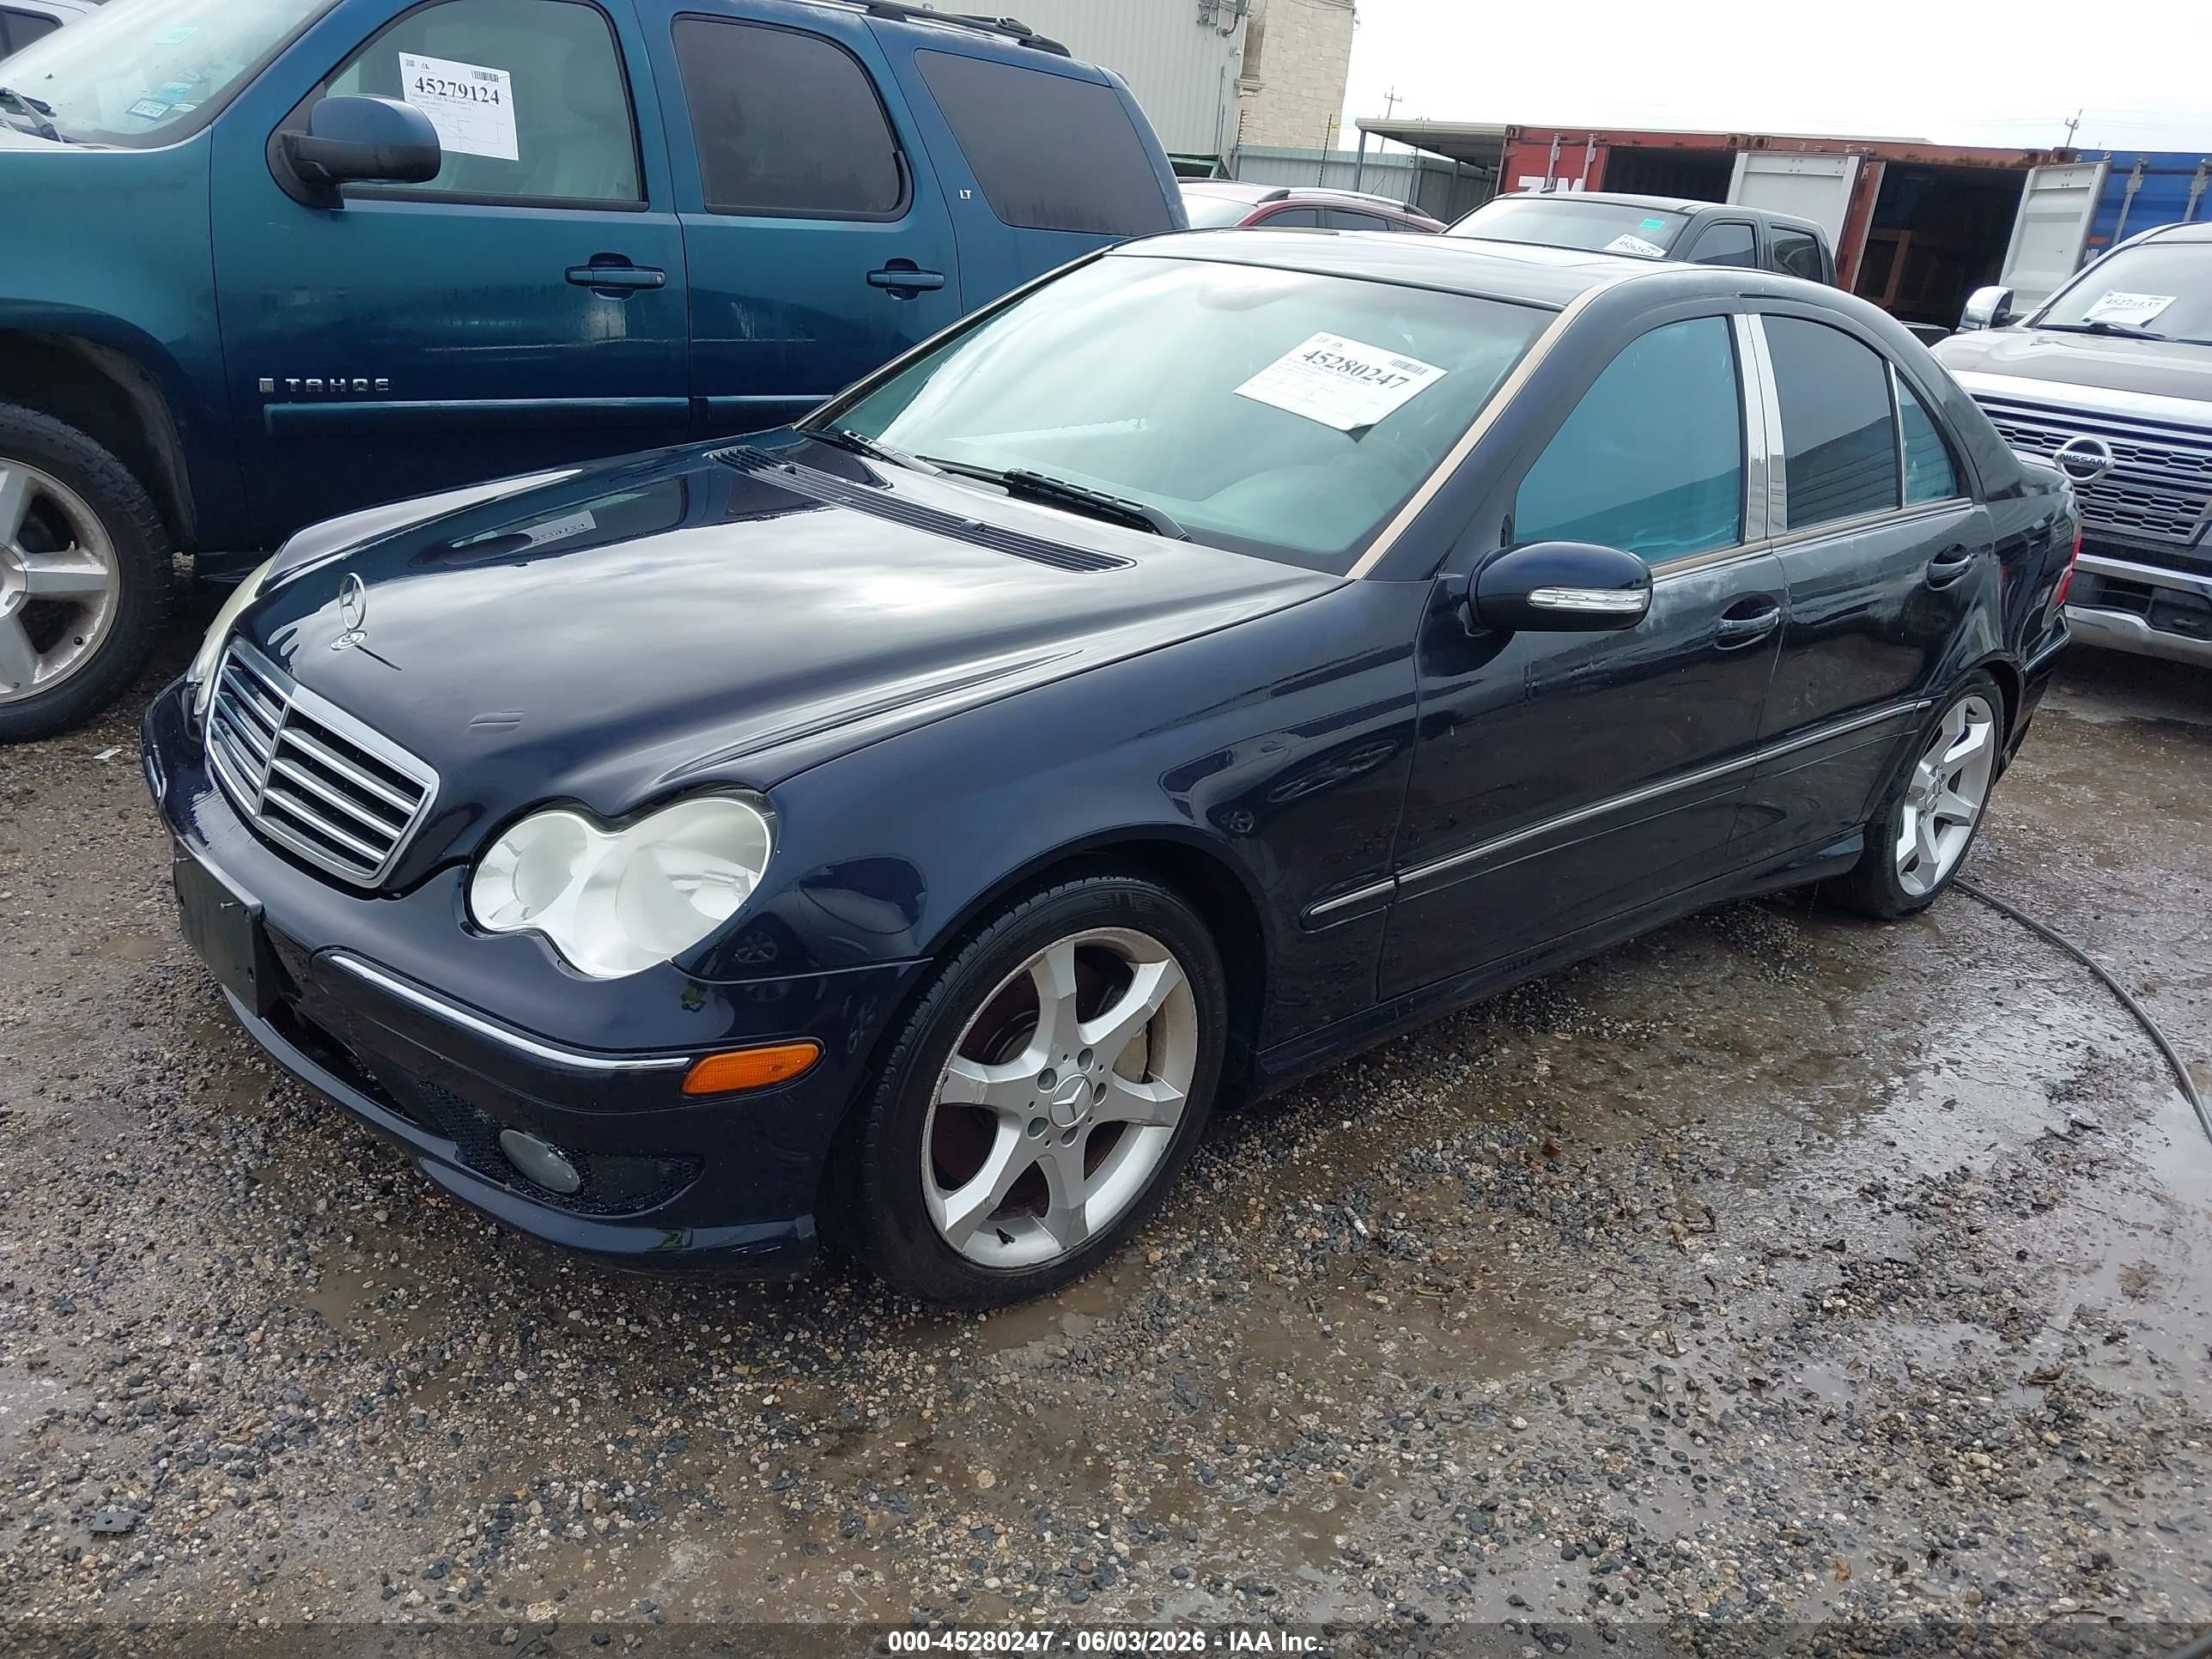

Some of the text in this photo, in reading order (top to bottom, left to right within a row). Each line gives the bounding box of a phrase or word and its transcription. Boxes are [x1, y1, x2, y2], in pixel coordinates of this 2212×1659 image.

[414, 76, 501, 105] 45279124
[958, 189, 972, 200] LT
[1302, 350, 1411, 389] 45280247
[285, 378, 389, 392] TAHOE
[2059, 453, 2107, 468] NISSAN
